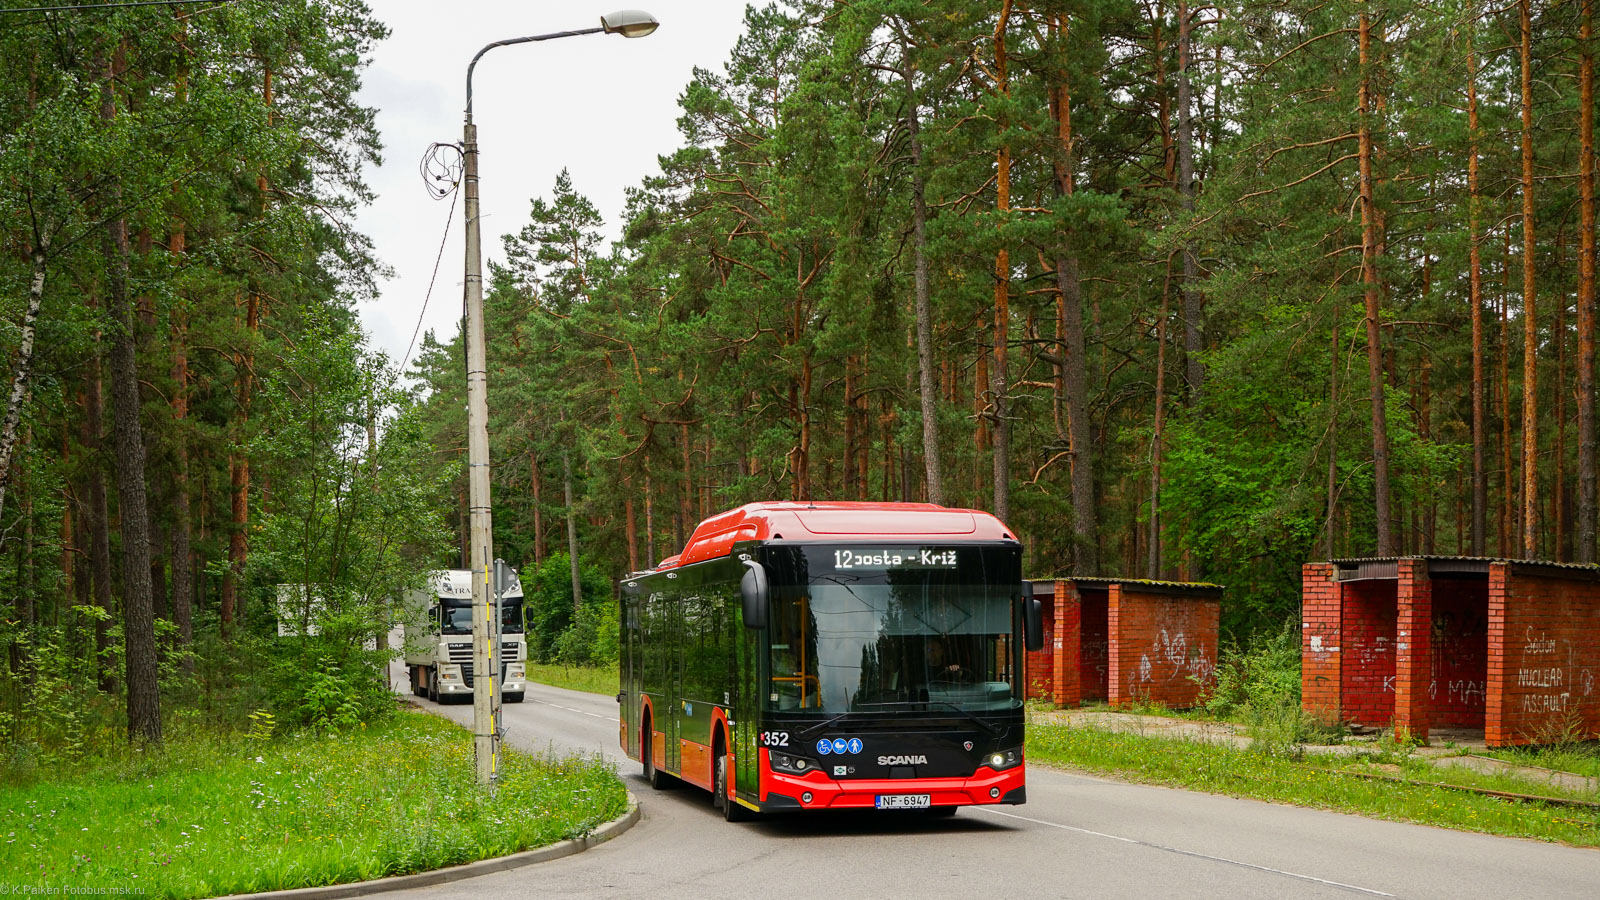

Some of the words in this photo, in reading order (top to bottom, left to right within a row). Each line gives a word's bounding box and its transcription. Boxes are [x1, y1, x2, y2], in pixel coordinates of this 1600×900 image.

[834, 550, 853, 569] 12
[921, 550, 957, 565] Križ
[1518, 667, 1563, 687] NUCLEAR
[1523, 692, 1570, 713] ASSAULT
[764, 731, 789, 747] 352
[877, 755, 928, 765] SCANIA
